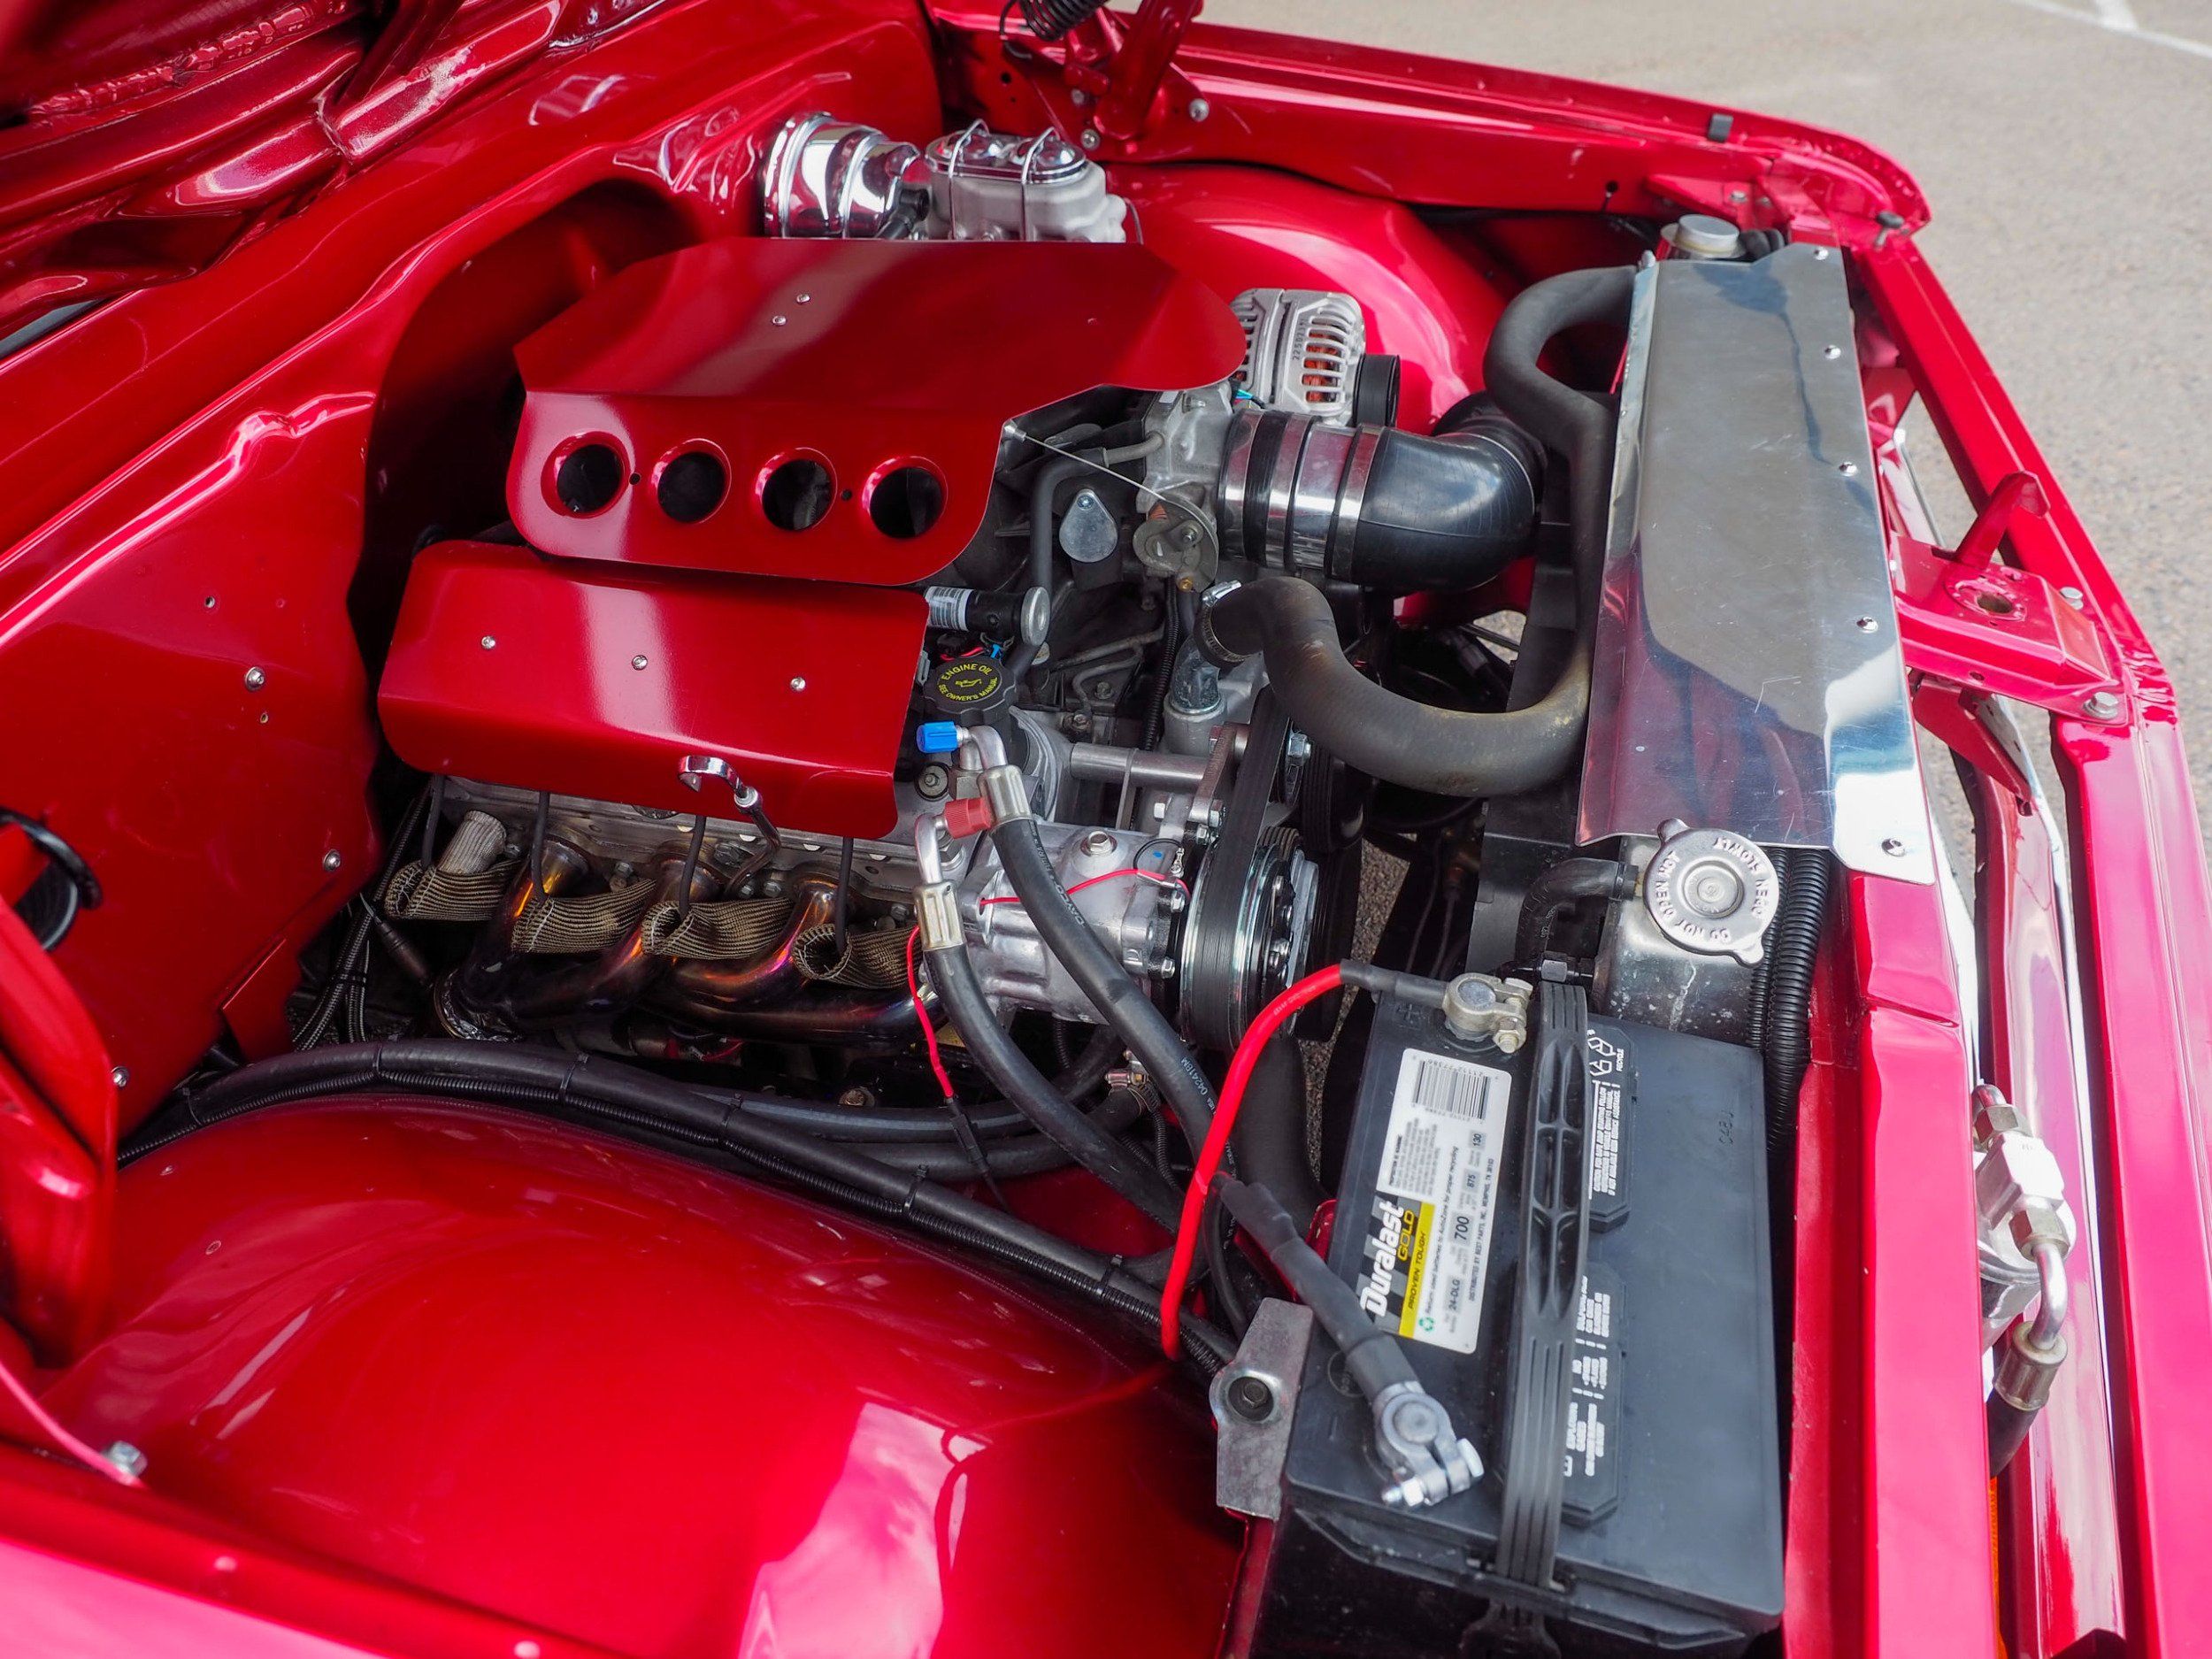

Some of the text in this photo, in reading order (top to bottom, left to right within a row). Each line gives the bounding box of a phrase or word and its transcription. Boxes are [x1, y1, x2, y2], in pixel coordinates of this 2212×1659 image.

[941, 663, 994, 680] ENGINE OIL
[938, 677, 997, 702] SEE OWNER'S MANUAL
[1657, 850, 1681, 878] HOT
[1713, 836, 1770, 918] OPEN SLOWLY
[1055, 884, 1085, 926] DAYCO
[1655, 879, 1678, 920] OPEN
[1674, 918, 1704, 937] NOT
[1616, 1048, 1624, 1071] RECYCLE
[1472, 1133, 1482, 1147] 130
[1448, 1146, 1459, 1173] recycling
[1445, 1174, 1455, 1194] proper
[1466, 1174, 1476, 1187] 875
[1397, 1210, 1417, 1262] GOLD
[1454, 1216, 1470, 1240] 700
[1361, 1200, 1405, 1317] Duralast
[1408, 1231, 1426, 1310] PROVEN TOUGH
[1448, 1279, 1462, 1310] 24-DLG
